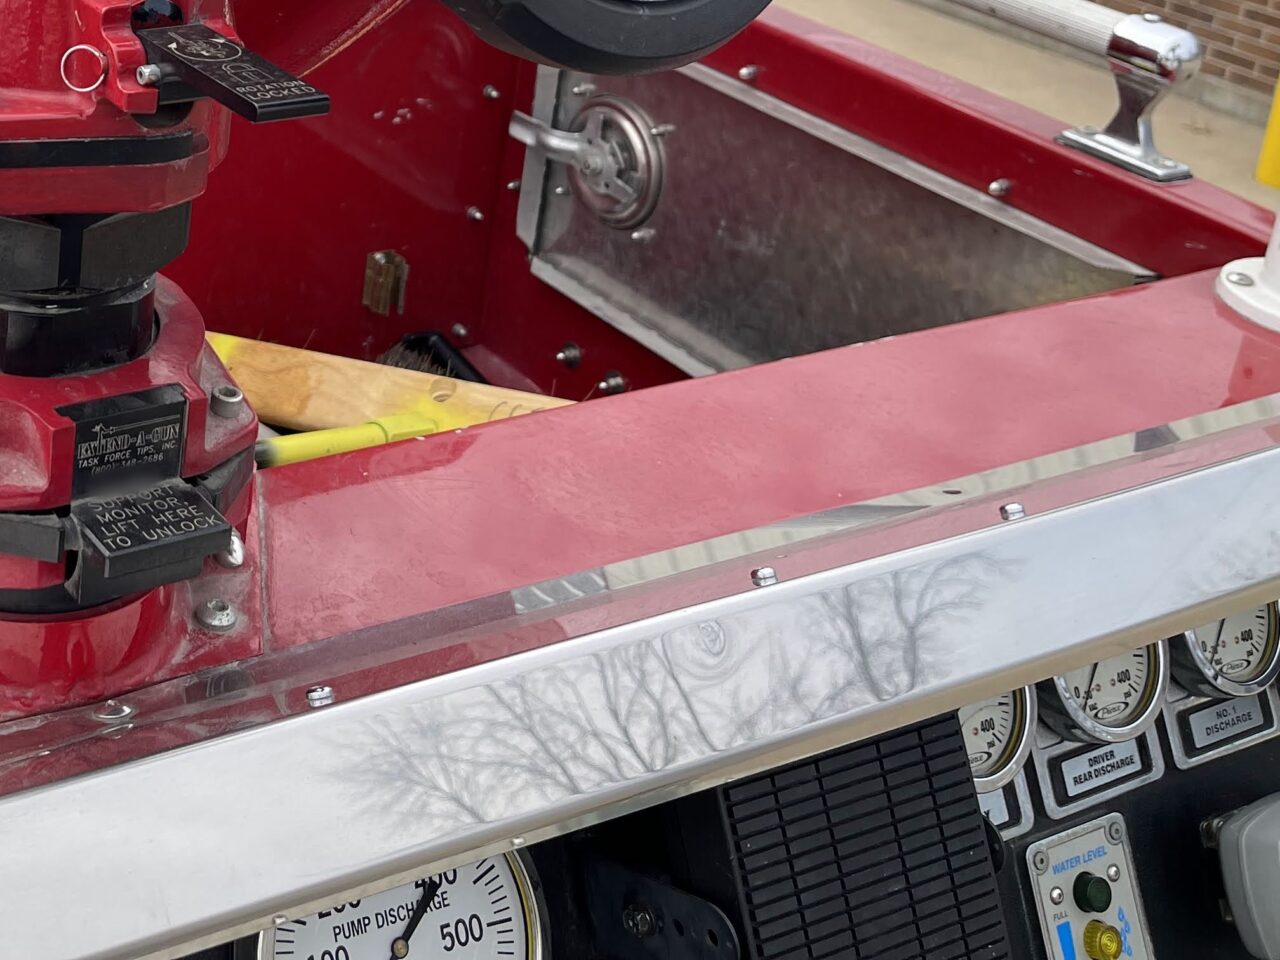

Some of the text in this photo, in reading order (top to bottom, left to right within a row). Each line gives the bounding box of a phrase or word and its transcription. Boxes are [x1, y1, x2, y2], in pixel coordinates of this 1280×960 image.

[236, 80, 307, 93] ROTATION
[246, 86, 316, 101] LOCKED
[78, 457, 100, 468] TASK
[104, 450, 132, 462] FORCE
[88, 485, 174, 511] SUPPORT
[96, 497, 189, 524] MONITOR,
[101, 505, 204, 537] LIFT HERE
[104, 514, 222, 550] TO UNLOCK
[1117, 669, 1131, 684] 400
[1074, 686, 1080, 698] 0
[1216, 705, 1236, 719] NO. 1
[980, 717, 995, 732] 400
[1205, 711, 1253, 736] DISCHARGE
[1088, 750, 1116, 767] DRIVER
[1073, 755, 1135, 786] REAR DISCHARGE
[1052, 845, 1108, 875] WATER LEVEL
[333, 916, 371, 942] PUMP
[375, 891, 450, 929] DISCHGE
[1053, 911, 1069, 920] FULL
[440, 913, 483, 952] 500
